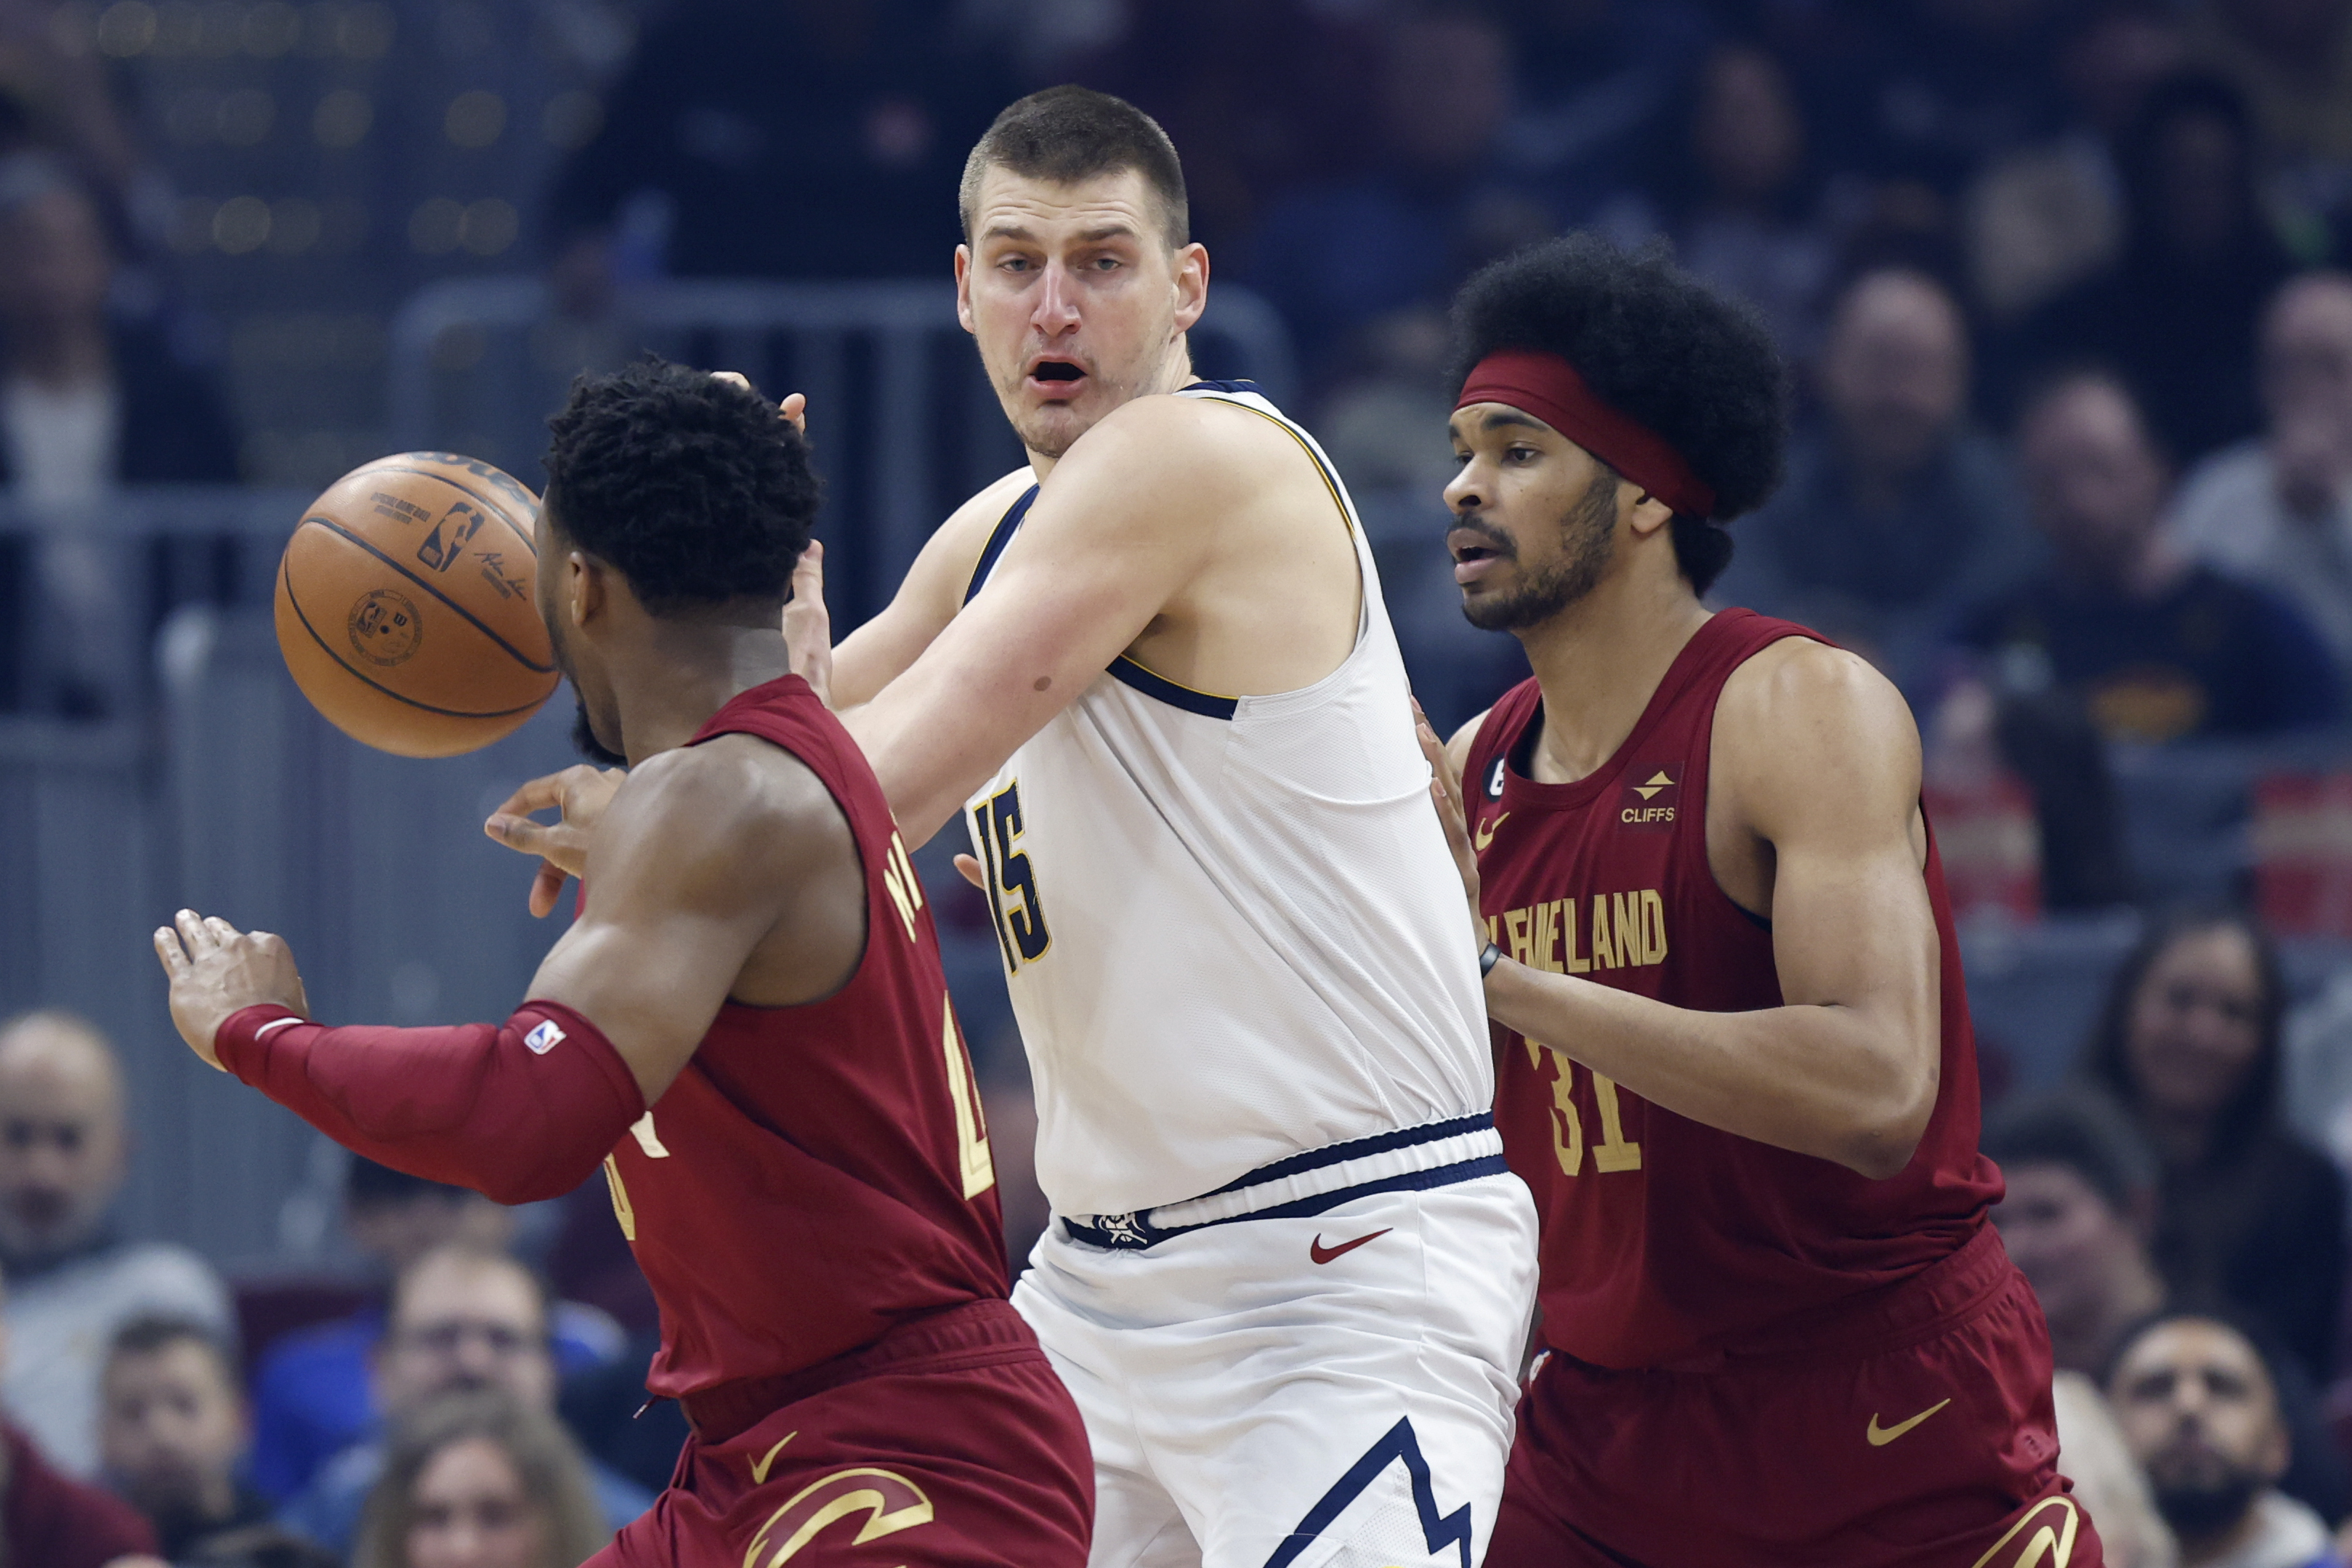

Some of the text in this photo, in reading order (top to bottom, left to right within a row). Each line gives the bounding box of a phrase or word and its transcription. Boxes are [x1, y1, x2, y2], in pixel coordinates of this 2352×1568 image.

[972, 776, 1053, 978] 15
[1621, 807, 1676, 823] CLIFFS
[1524, 1037, 1642, 1177] 31
